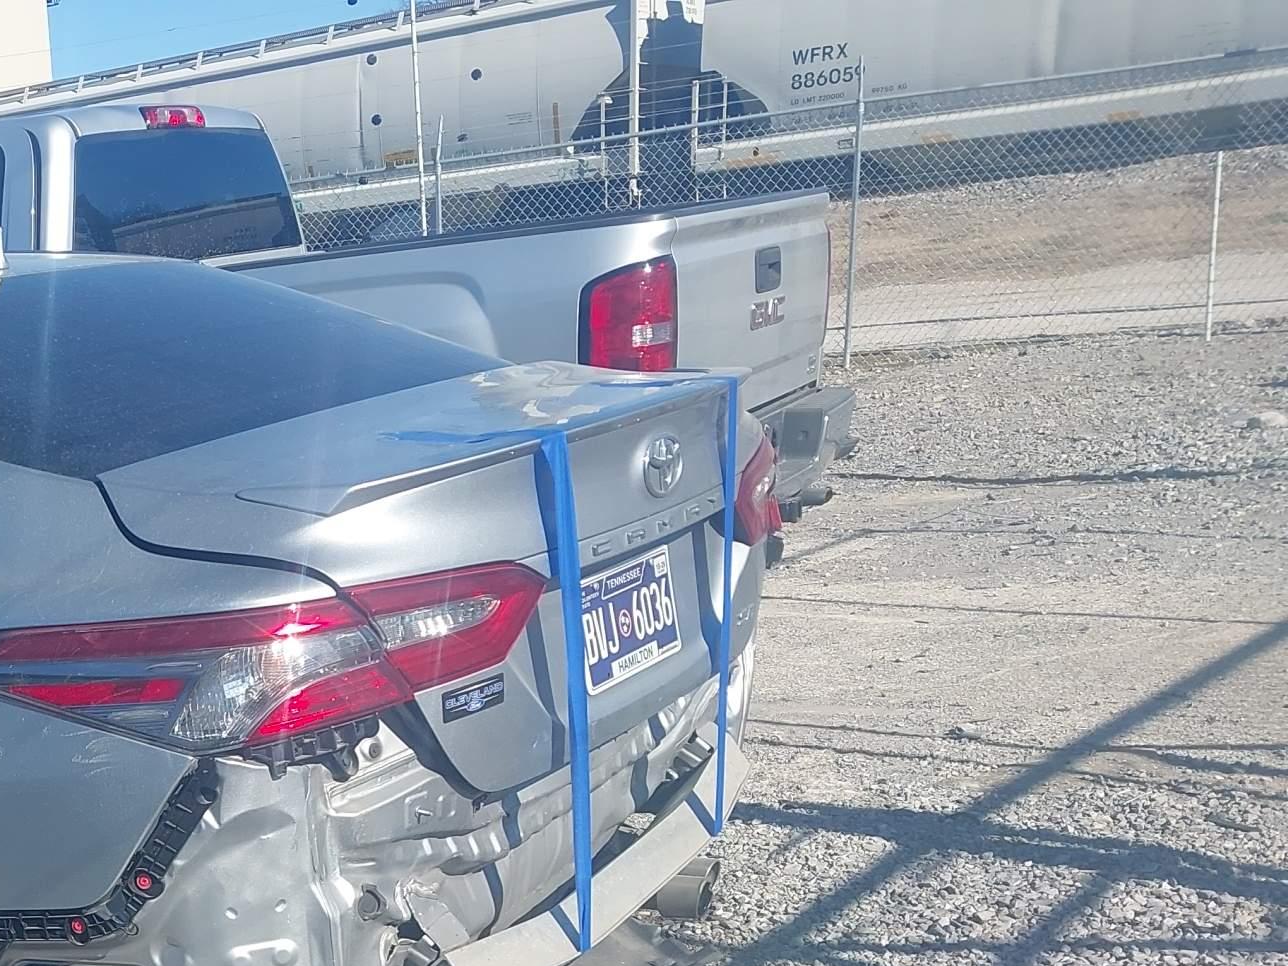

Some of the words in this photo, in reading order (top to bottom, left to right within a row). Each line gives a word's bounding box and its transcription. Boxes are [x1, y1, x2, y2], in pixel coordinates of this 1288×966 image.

[793, 42, 848, 65] WFRX
[750, 296, 786, 331] GMC
[606, 567, 642, 590] TENNESSEE
[582, 602, 620, 665] BVJ
[632, 577, 674, 641] 6036
[618, 645, 654, 673] HAMILTON
[445, 682, 504, 710] CLEVELAND
